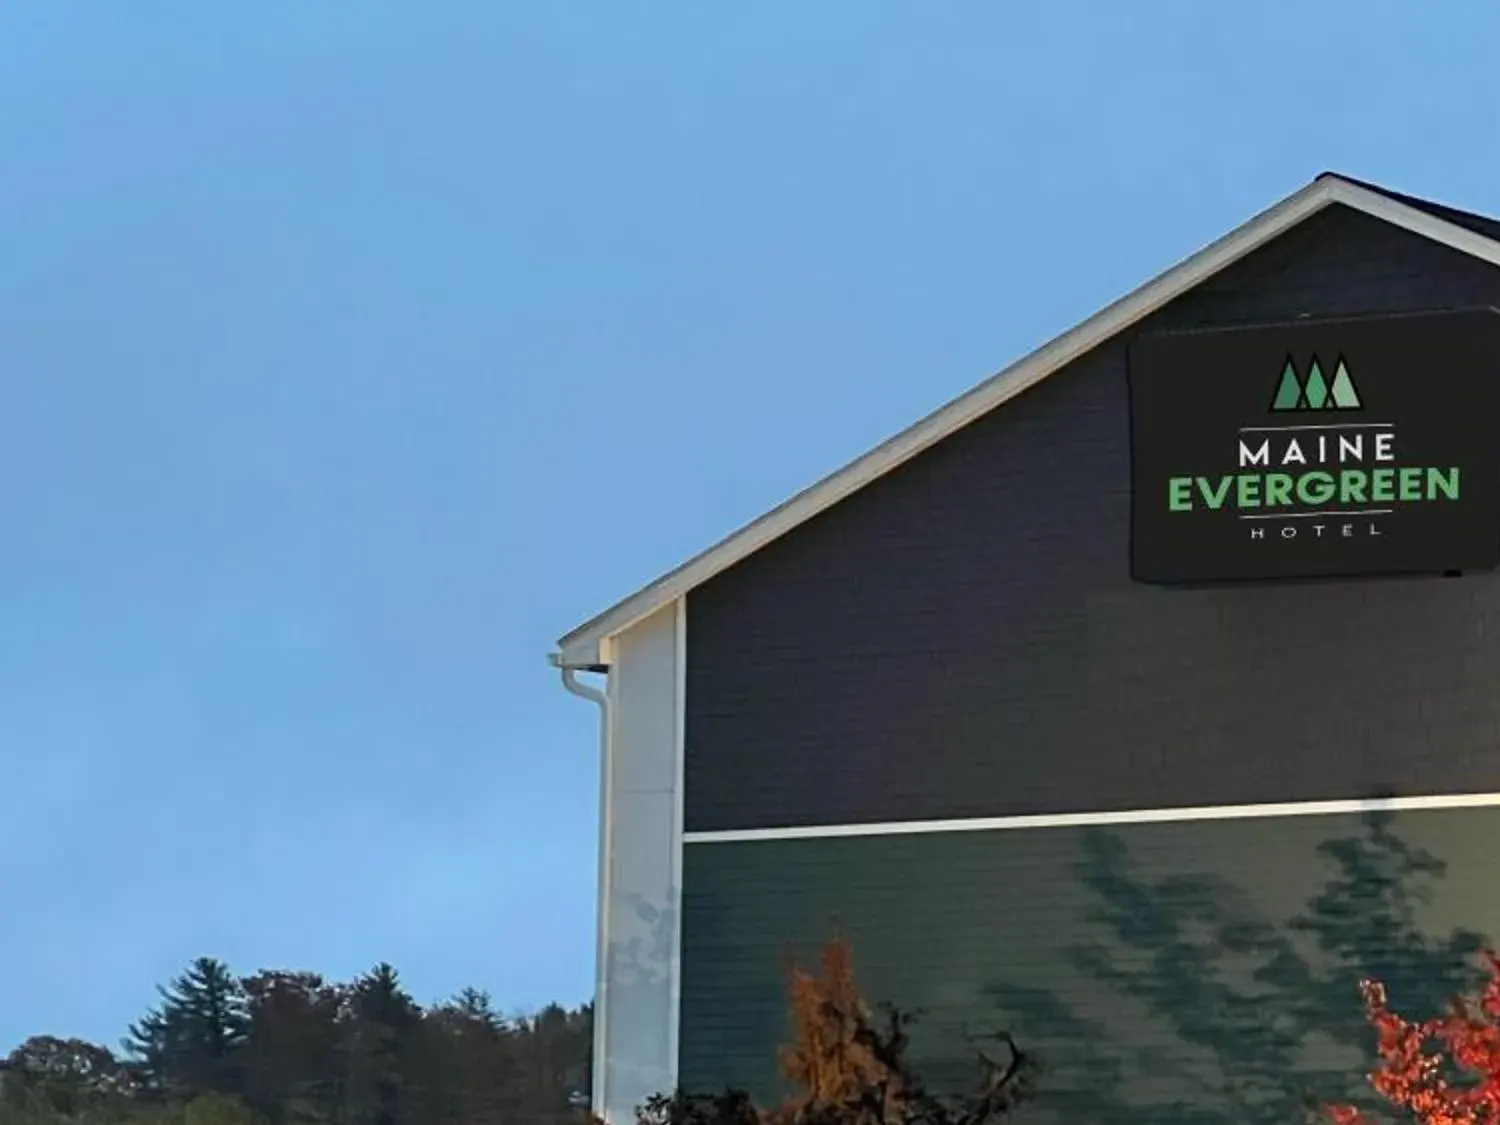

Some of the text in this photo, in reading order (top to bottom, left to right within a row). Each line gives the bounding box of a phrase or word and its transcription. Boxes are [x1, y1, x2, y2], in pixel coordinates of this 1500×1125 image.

[1239, 433, 1395, 467] MAINE
[1168, 467, 1460, 511] EVERGREEN
[1251, 523, 1382, 539] HOTEL
